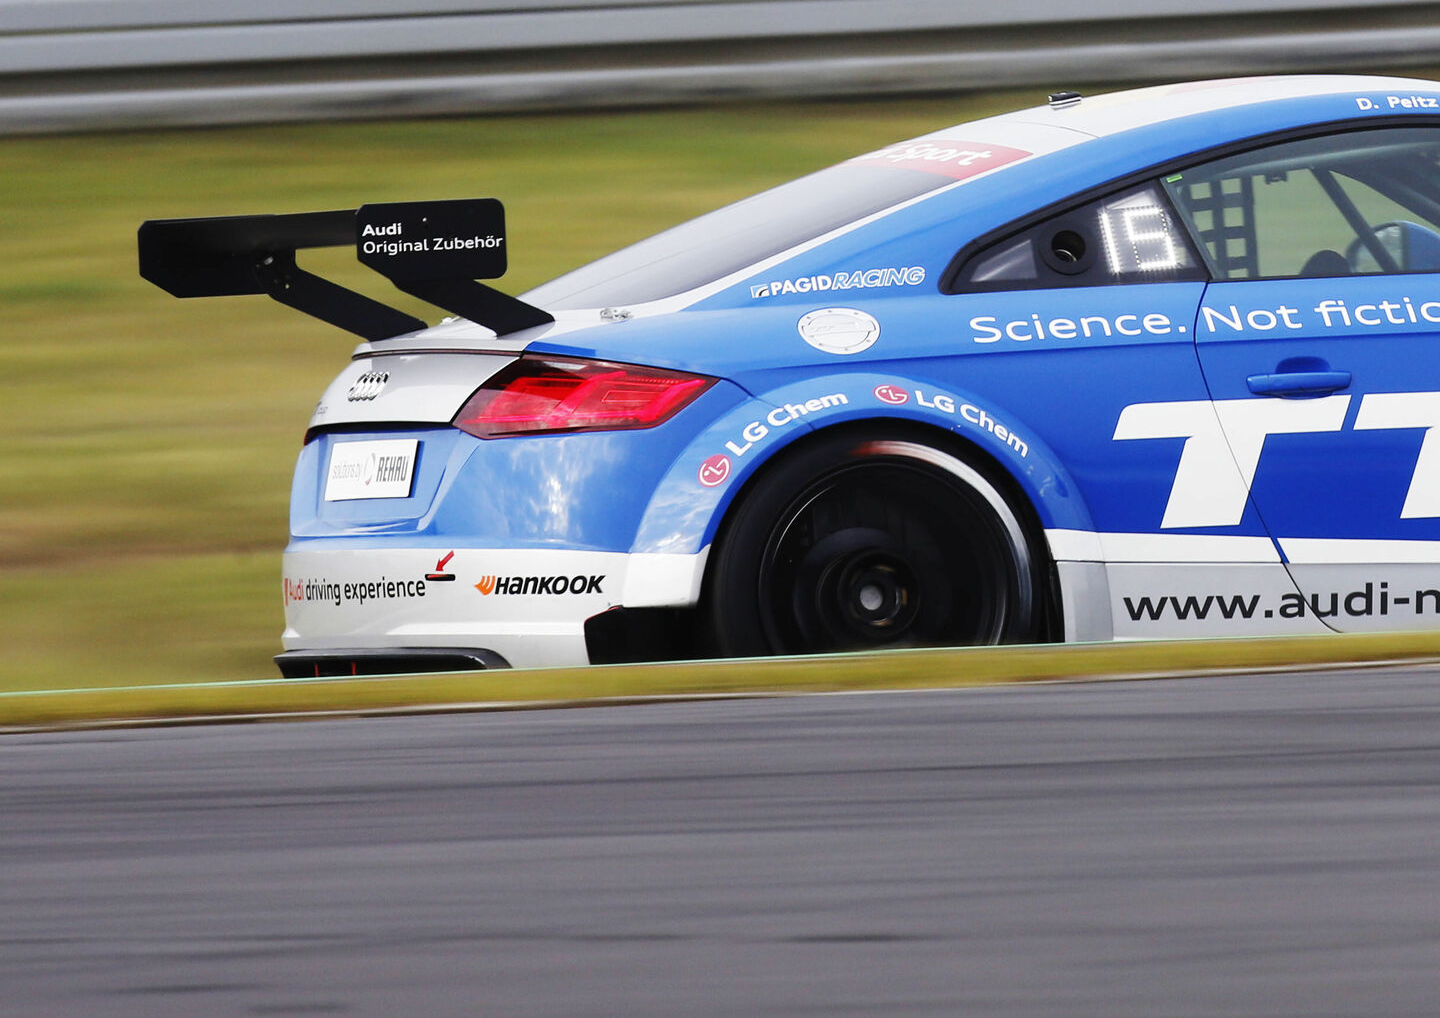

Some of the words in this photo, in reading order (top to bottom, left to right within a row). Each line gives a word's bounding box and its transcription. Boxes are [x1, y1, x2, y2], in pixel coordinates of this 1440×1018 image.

[1355, 97, 1380, 111] D.
[1387, 95, 1439, 109] Peltz
[362, 222, 402, 237] Audi
[1099, 206, 1177, 273] 15
[363, 239, 430, 256] Original
[433, 235, 503, 251] Zubehör
[968, 311, 1187, 344] Science.
[1202, 303, 1304, 334] Not
[725, 422, 769, 457] LG
[766, 391, 849, 427] Chem
[914, 389, 956, 414] LG
[959, 403, 1029, 458] Chem
[376, 455, 411, 482] REHAU
[305, 578, 341, 606] driving
[344, 576, 426, 605] experience
